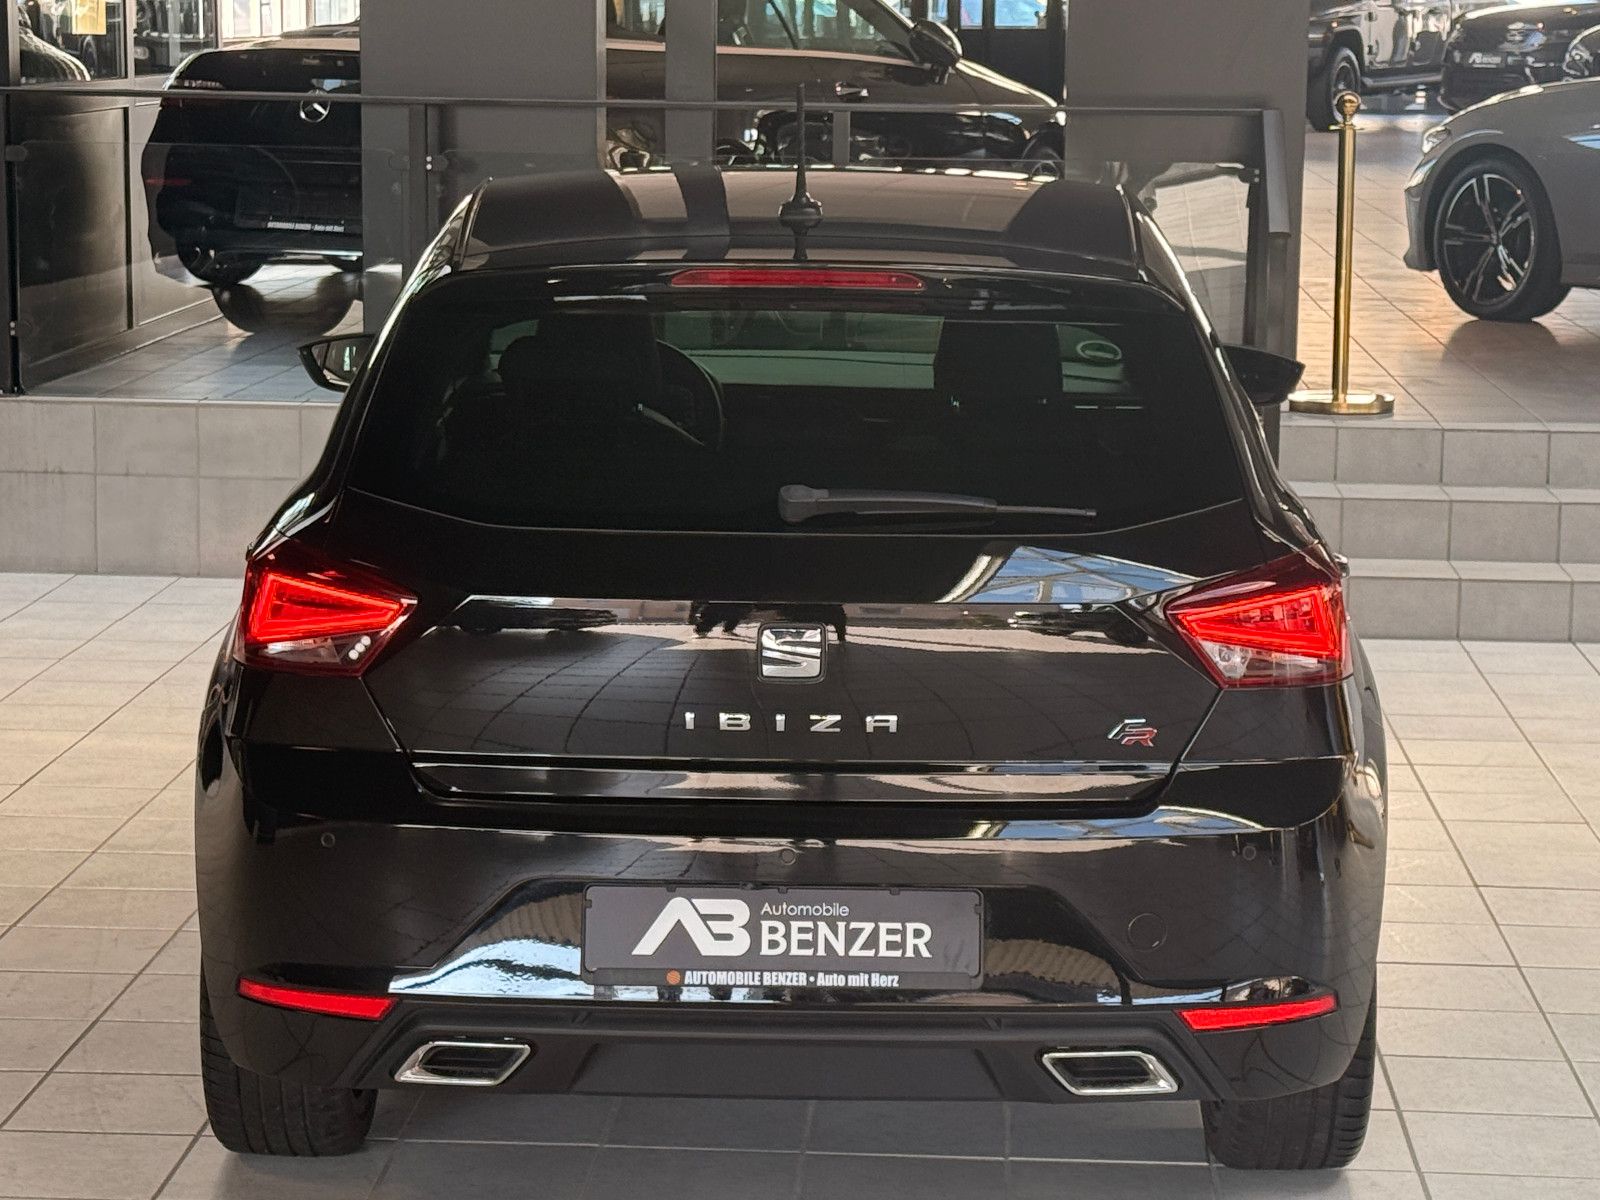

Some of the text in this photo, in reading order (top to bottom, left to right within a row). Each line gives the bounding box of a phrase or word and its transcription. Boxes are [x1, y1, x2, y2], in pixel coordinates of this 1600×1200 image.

[684, 711, 898, 733] IBIZA
[1107, 718, 1157, 747] FR
[760, 901, 850, 918] Automobile
[759, 920, 933, 958] BENZER
[684, 970, 900, 988] AUTOMOBILE BENZER Auto mit Herz
